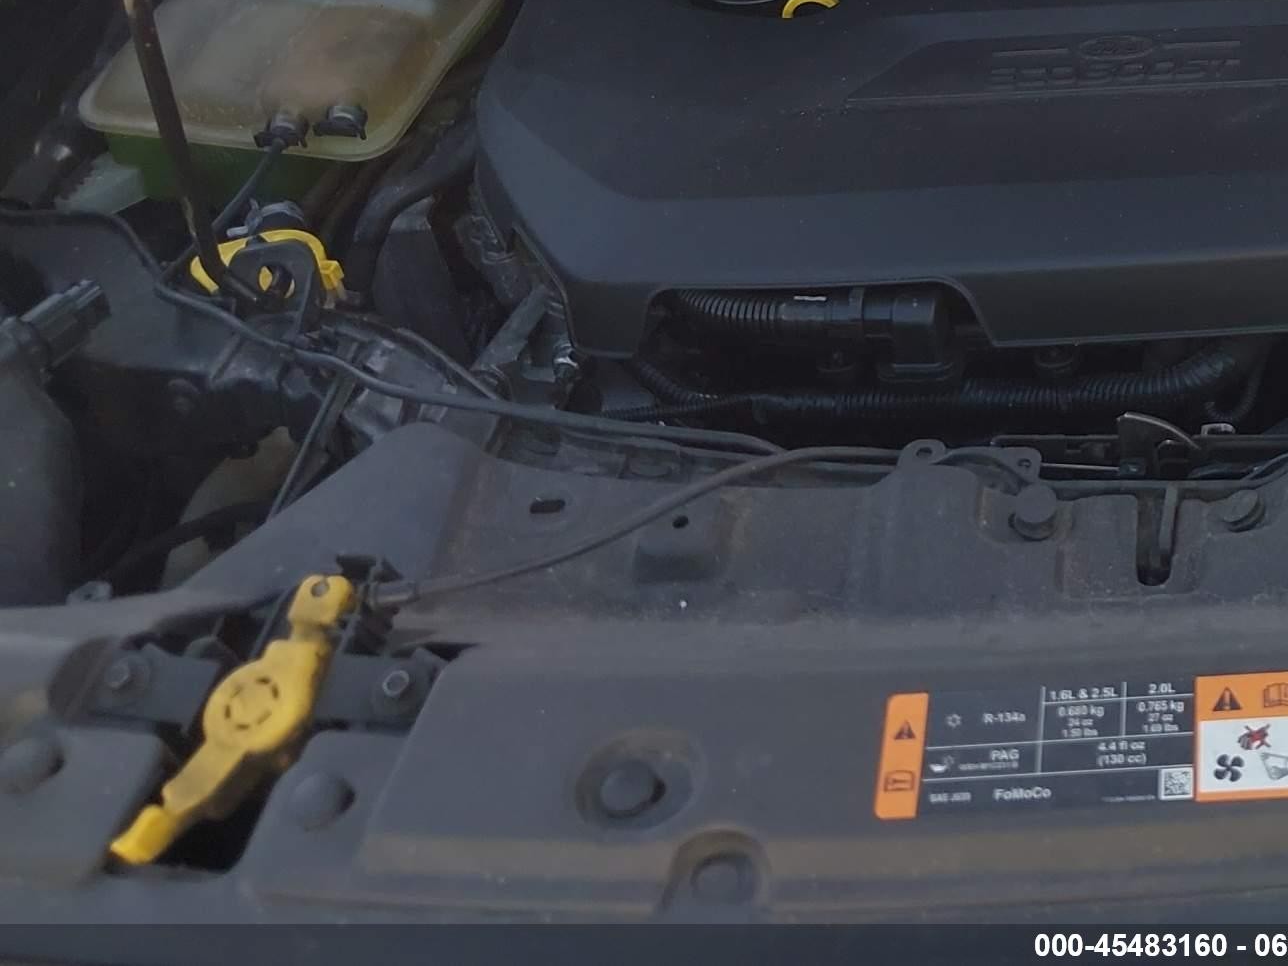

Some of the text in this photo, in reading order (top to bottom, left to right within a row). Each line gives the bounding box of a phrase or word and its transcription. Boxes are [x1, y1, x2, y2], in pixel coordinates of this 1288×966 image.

[1050, 687, 1118, 701] 1.6L & 2.5L
[1148, 683, 1176, 694] 2.0L
[1170, 700, 1185, 713] kg
[983, 712, 1027, 723] R-134a
[991, 750, 1020, 761] PAG
[994, 786, 1053, 801] FoMoCo
